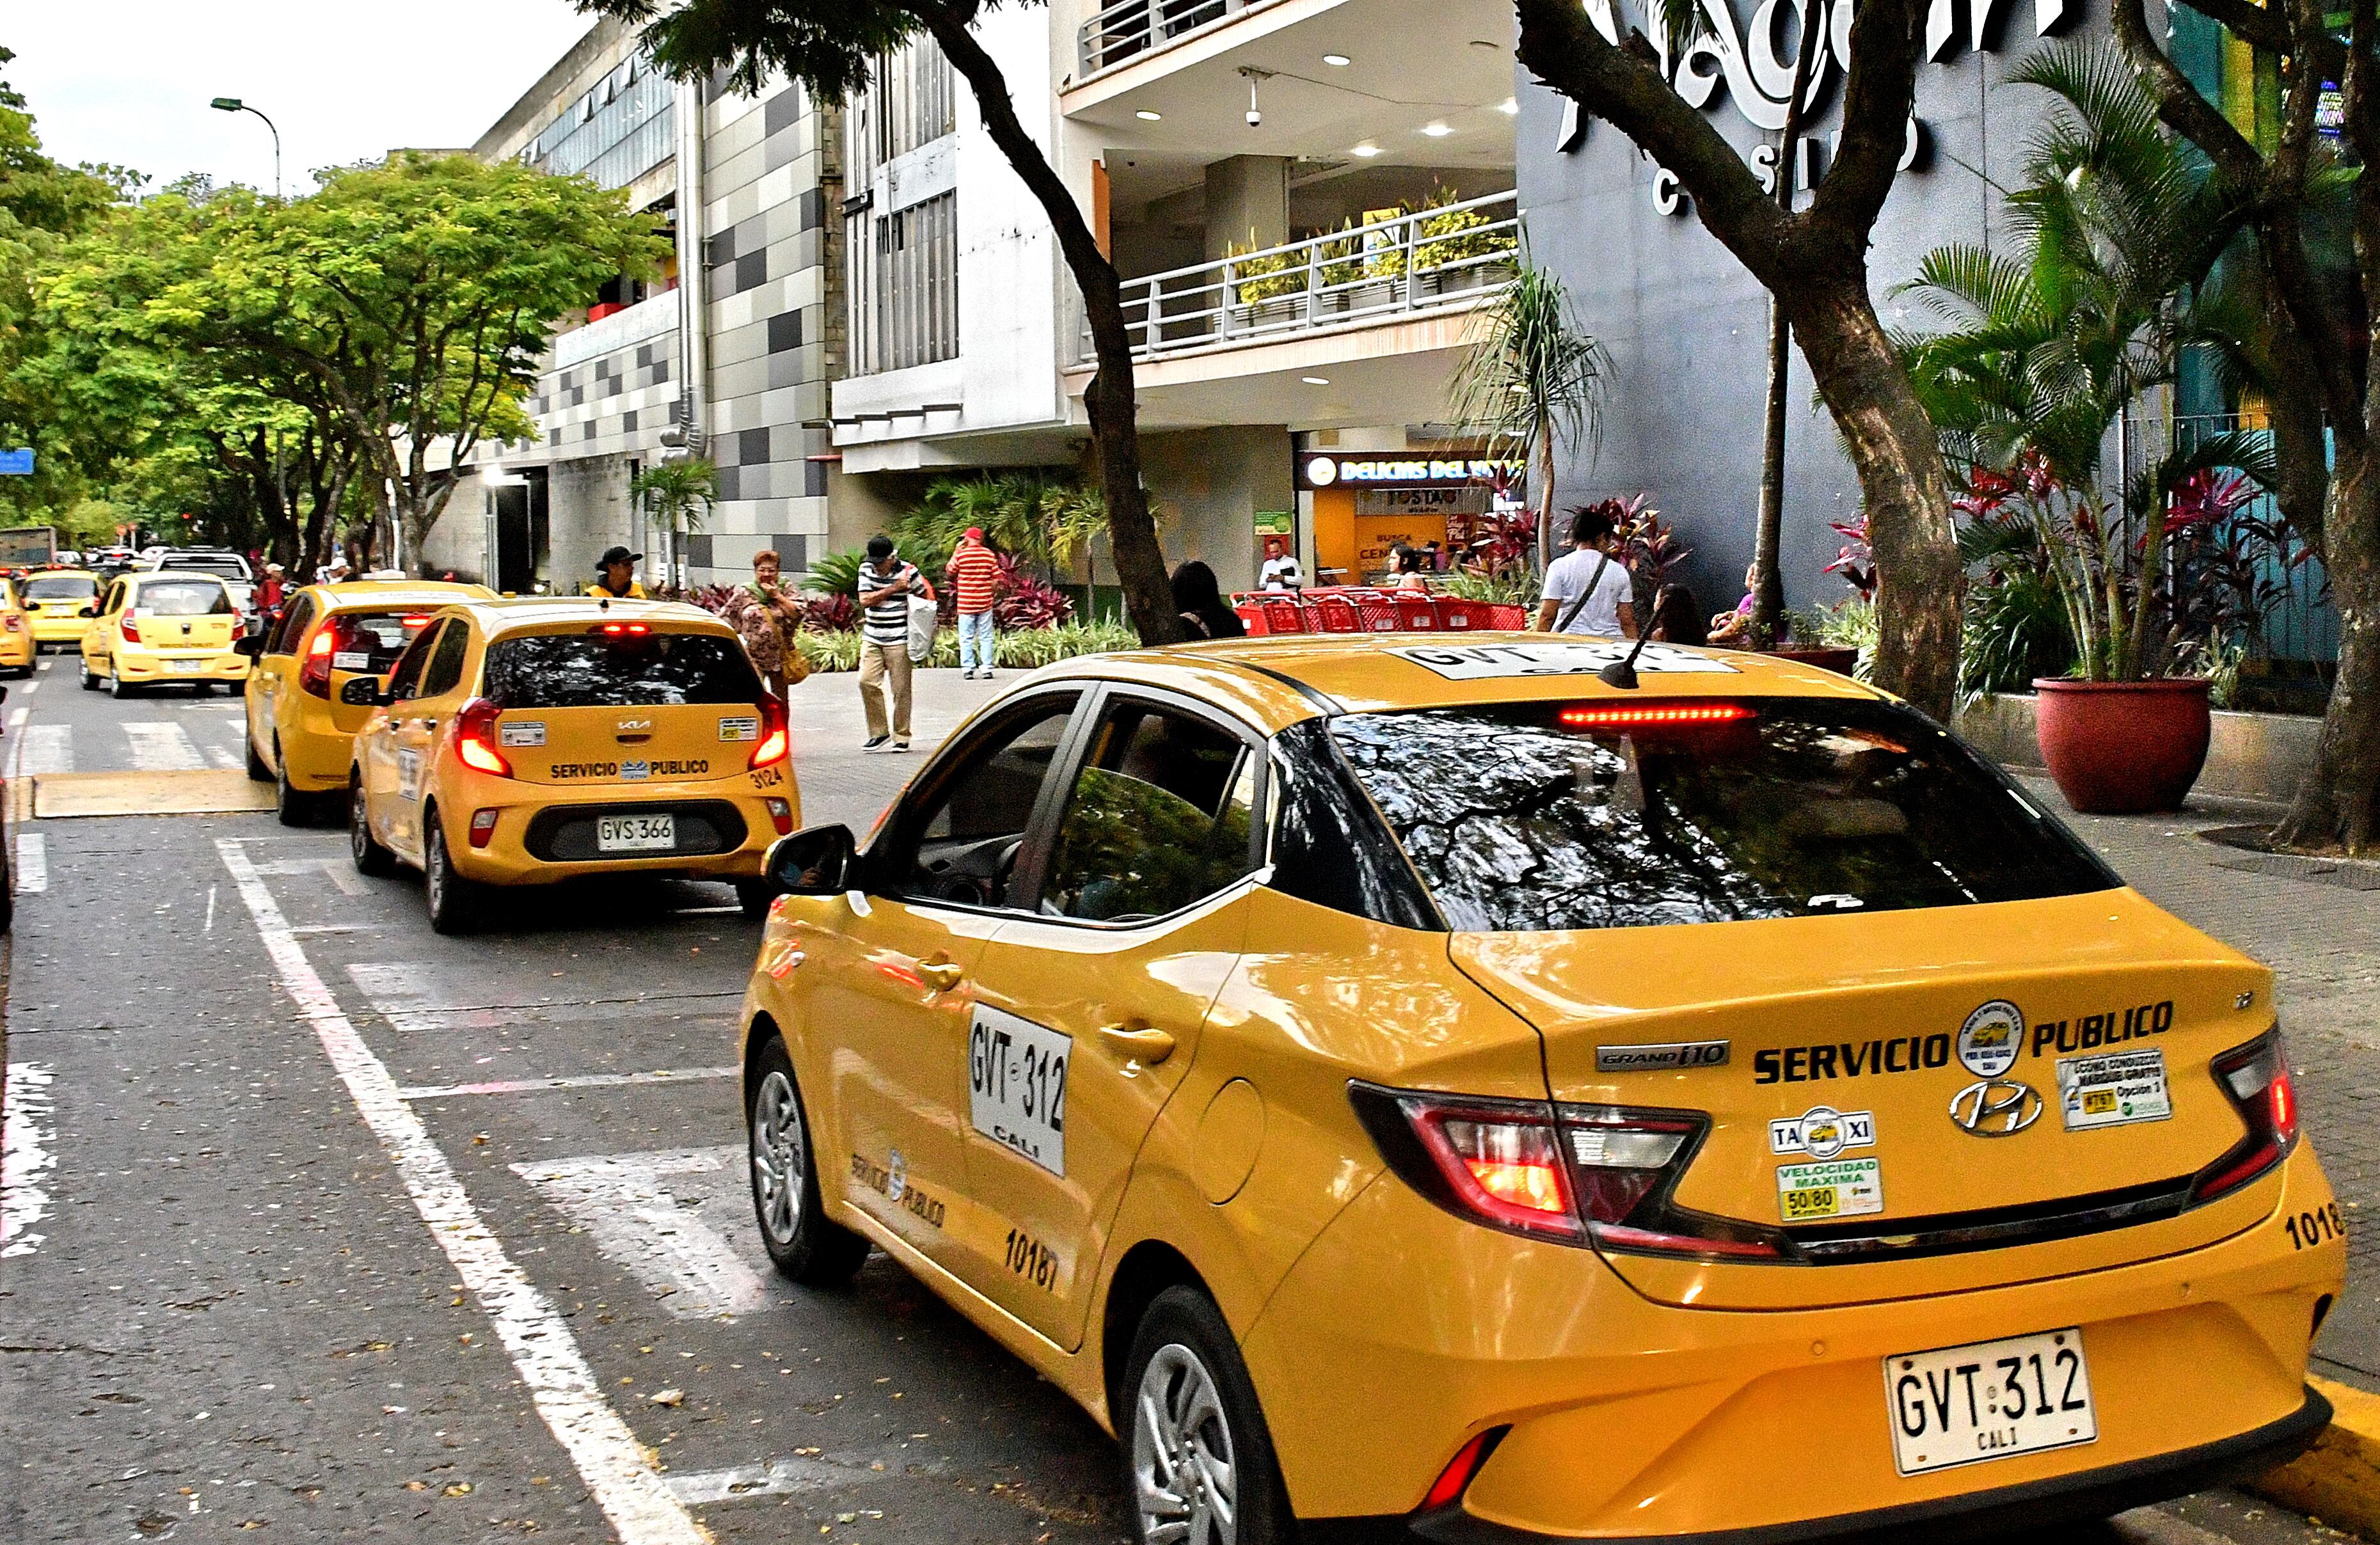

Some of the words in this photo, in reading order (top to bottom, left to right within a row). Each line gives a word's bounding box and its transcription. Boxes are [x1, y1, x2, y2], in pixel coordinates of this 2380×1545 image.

[1430, 459, 1467, 479] DEL
[1405, 647, 1540, 665] GVT
[551, 762, 617, 779] SERVICIO
[651, 759, 708, 775] PUBLICO
[750, 768, 784, 790] 3124
[601, 820, 633, 841] GVS
[639, 819, 671, 839] 366
[1755, 1033, 1950, 1084] SERVICIO
[2032, 1001, 2173, 1058] PUBLICO
[1603, 1052, 1676, 1065] GRAND
[1678, 1045, 1725, 1066] i10
[971, 1022, 1012, 1104] GVT
[1024, 1043, 1065, 1132] 312
[994, 1125, 1040, 1159] CALI
[1775, 1127, 1802, 1145] TA
[1849, 1121, 1869, 1139] XI
[1779, 1161, 1876, 1178] VELOCIDAD
[1795, 1173, 1864, 1188] MAXIMA
[1006, 1228, 1058, 1292] 10187
[1898, 1363, 1981, 1438] GVT
[1995, 1348, 2086, 1420] 312
[1978, 1426, 2017, 1450] CALI
